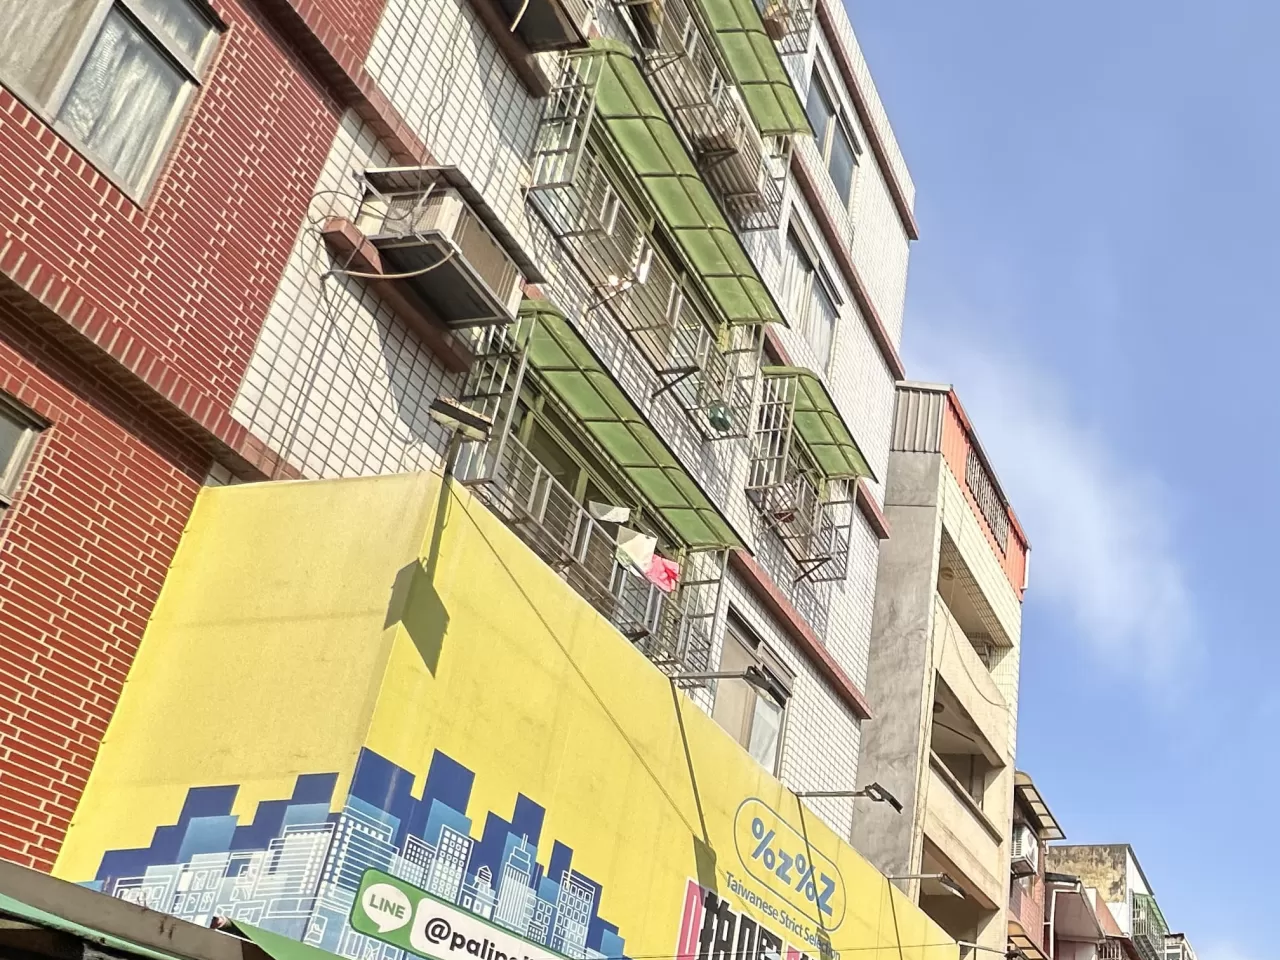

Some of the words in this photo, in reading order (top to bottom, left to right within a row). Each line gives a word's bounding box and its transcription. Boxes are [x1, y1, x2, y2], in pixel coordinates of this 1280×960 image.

[369, 893, 406, 920] LINE
[726, 871, 779, 920] Taiwanese
[779, 911, 806, 939] Strict
